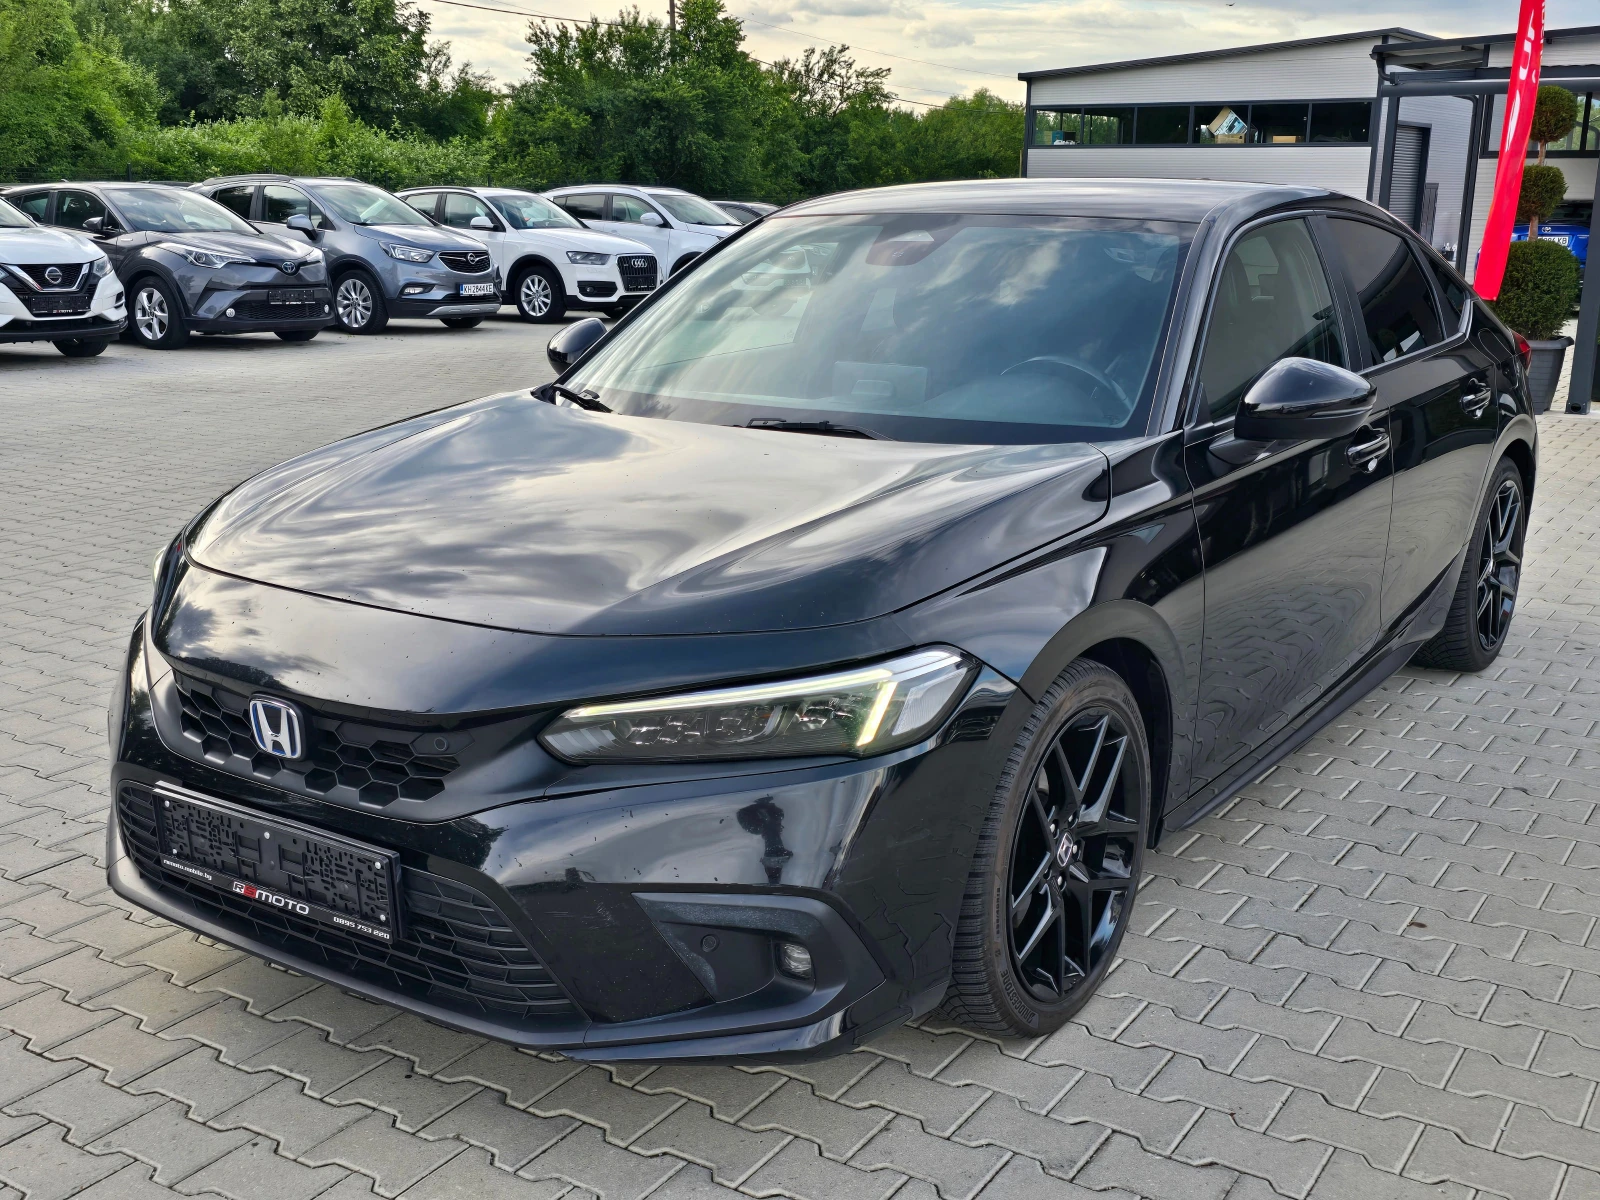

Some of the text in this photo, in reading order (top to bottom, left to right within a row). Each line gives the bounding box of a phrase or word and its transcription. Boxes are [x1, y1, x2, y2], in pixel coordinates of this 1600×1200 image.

[163, 858, 213, 881] rsmoto.mobile.bg
[232, 881, 310, 915] RSMOTO
[333, 916, 390, 940] 0895 753 220
[1000, 968, 1036, 1024] BRIDGESTONE
